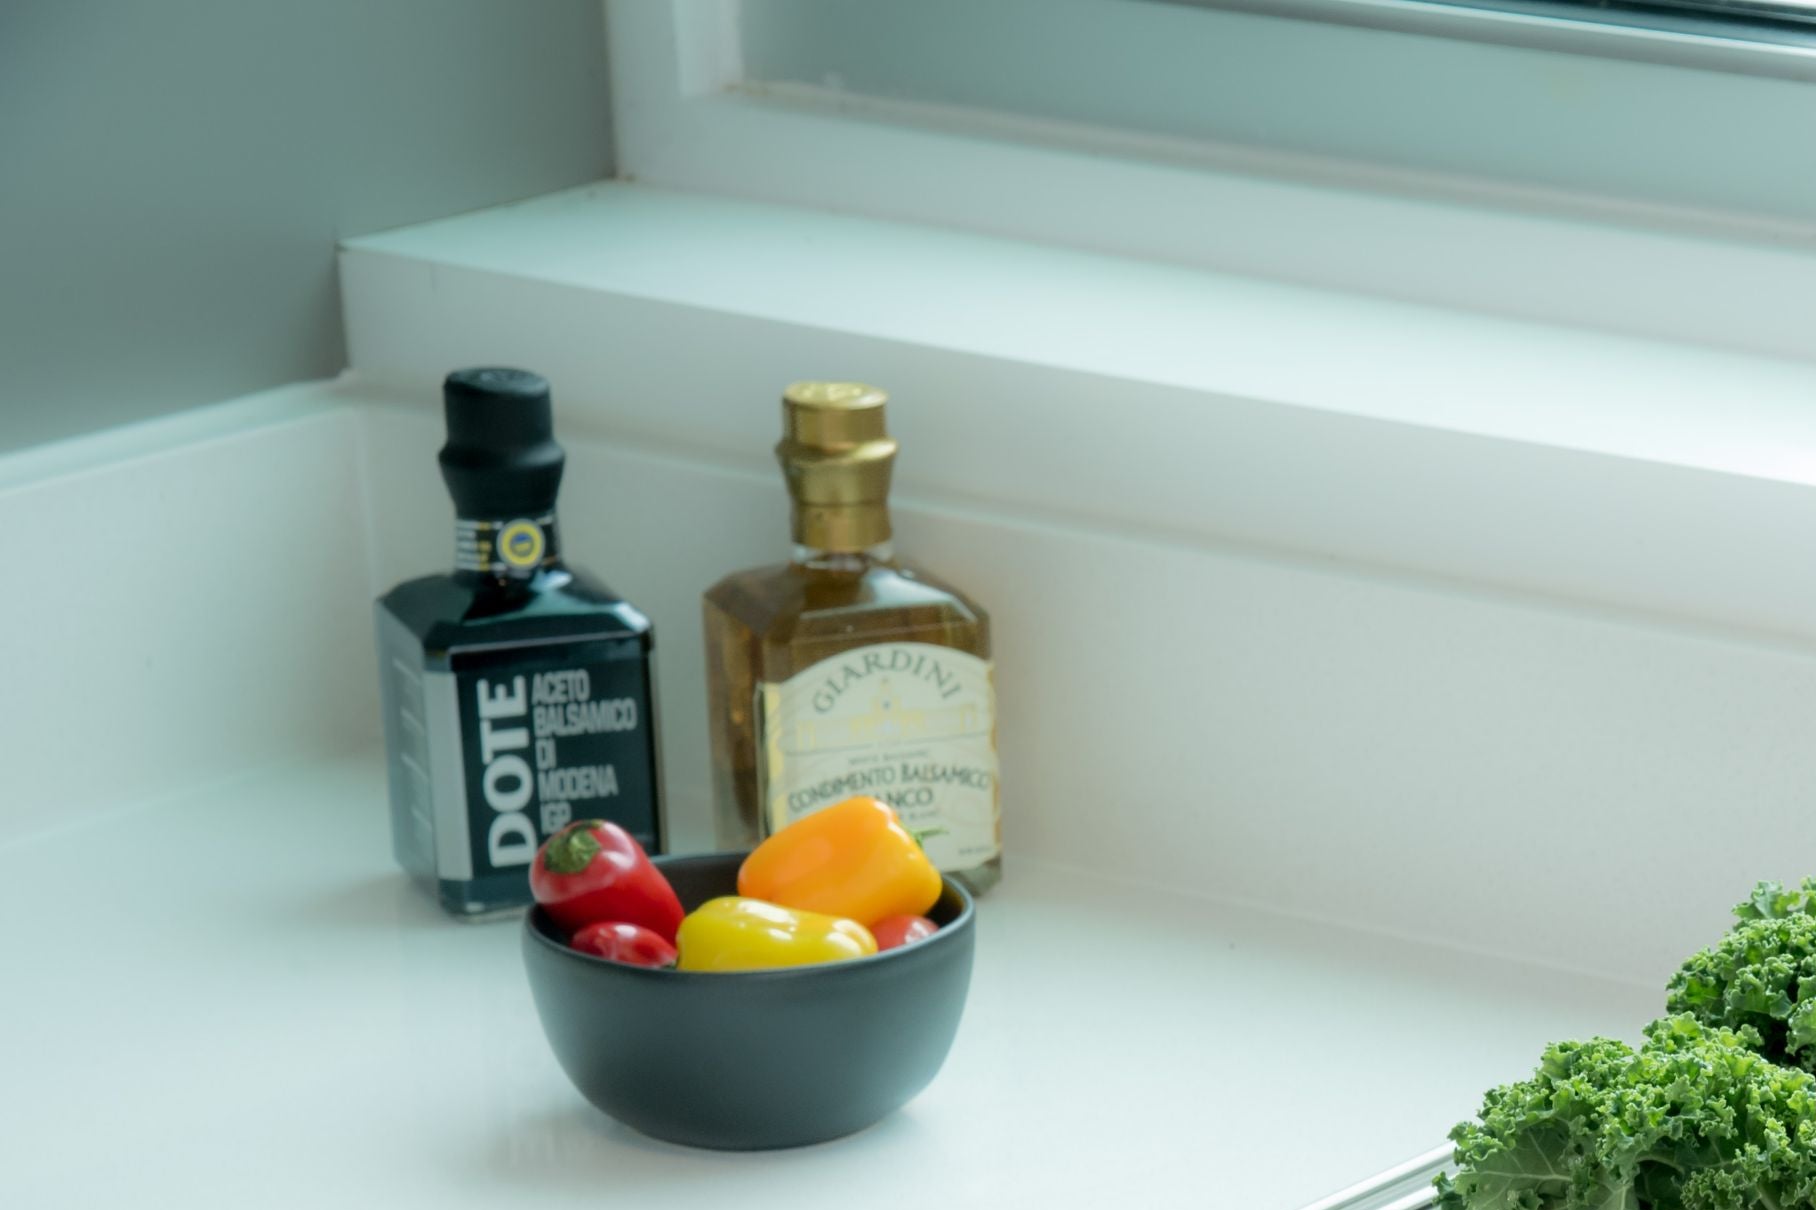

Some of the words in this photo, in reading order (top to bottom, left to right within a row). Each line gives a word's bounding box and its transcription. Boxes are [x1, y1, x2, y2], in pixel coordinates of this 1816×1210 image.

[532, 669, 590, 705] ACETO
[812, 648, 962, 713] GIARDINI
[533, 698, 638, 737] BALSAMICO
[476, 675, 538, 868] DOTE
[536, 739, 557, 769] DI
[538, 765, 619, 803] MODENA
[787, 767, 896, 811] CONDIMENTO
[901, 763, 990, 791] BALSAMICO
[873, 786, 934, 808] NCO
[541, 802, 572, 834] IGP
